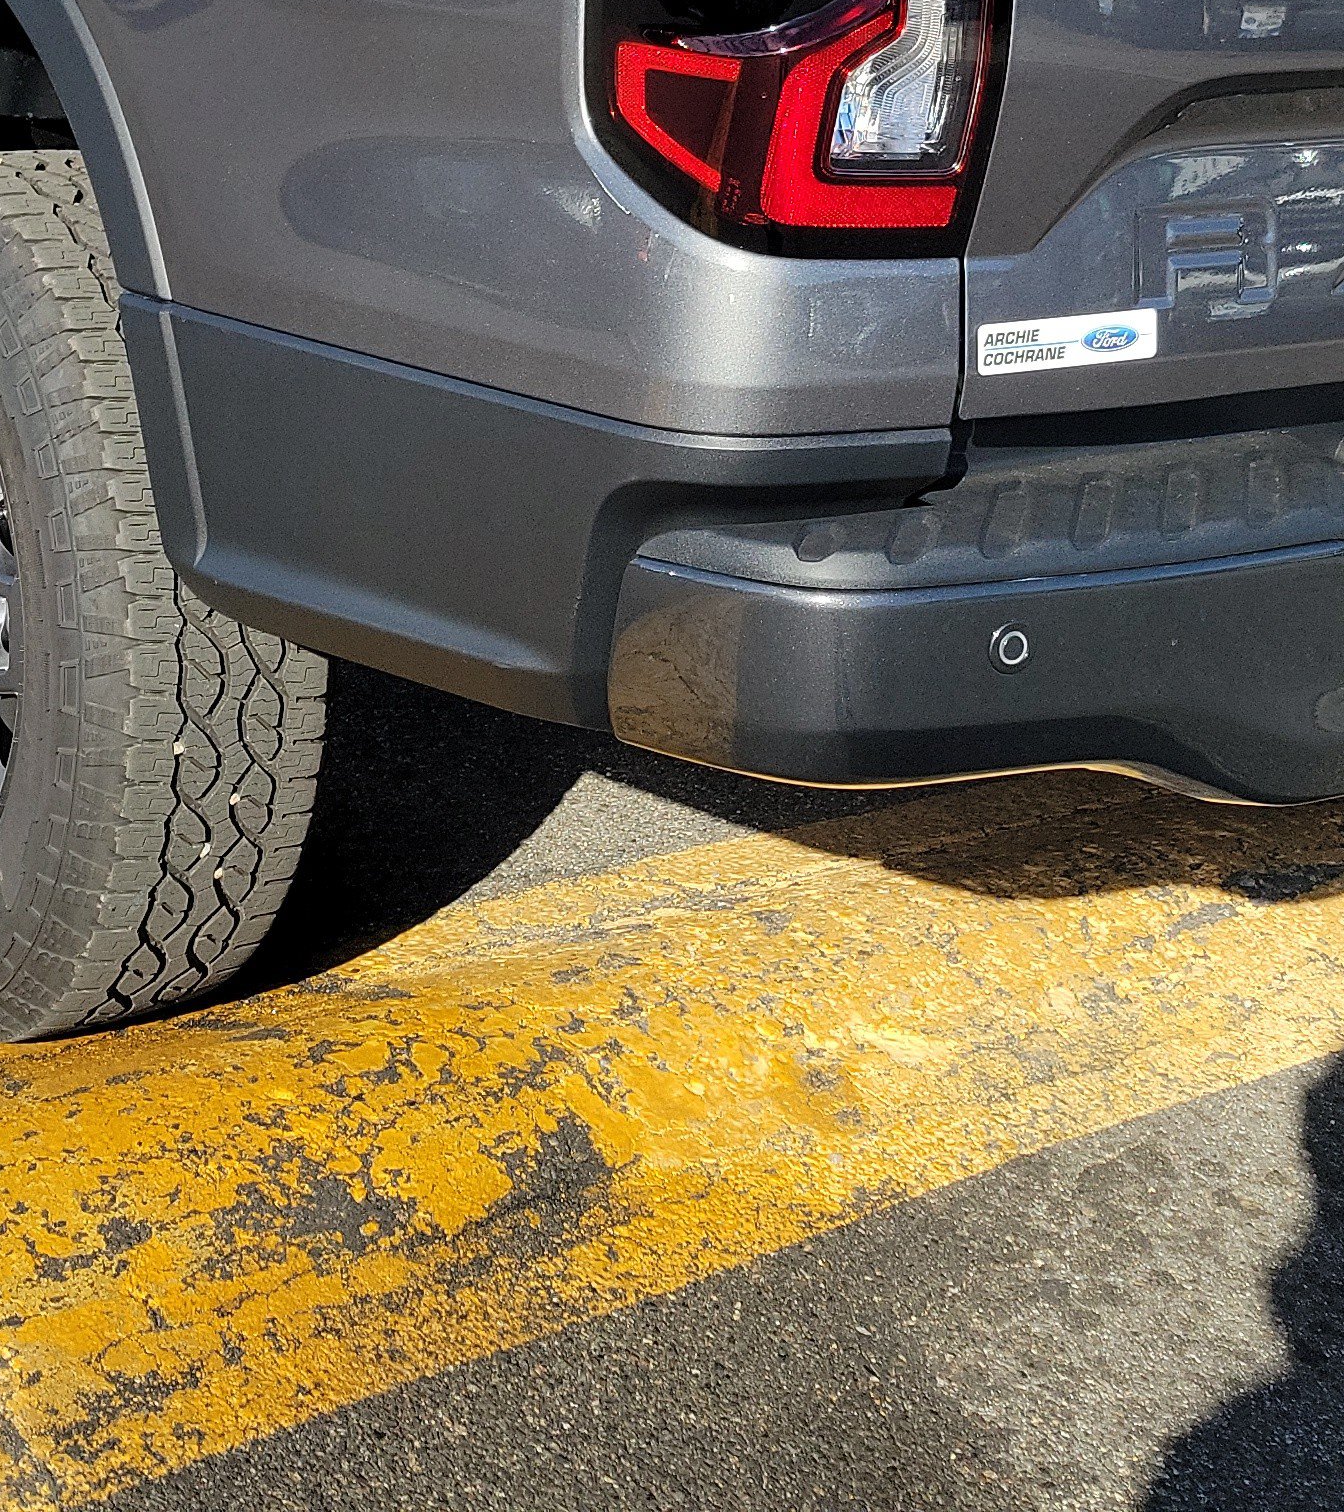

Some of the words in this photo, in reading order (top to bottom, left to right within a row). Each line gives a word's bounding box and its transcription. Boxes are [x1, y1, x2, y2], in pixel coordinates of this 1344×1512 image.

[984, 328, 1041, 348] ARCHIE
[1092, 328, 1129, 349] Ford
[983, 345, 1067, 367] COCHRANE
